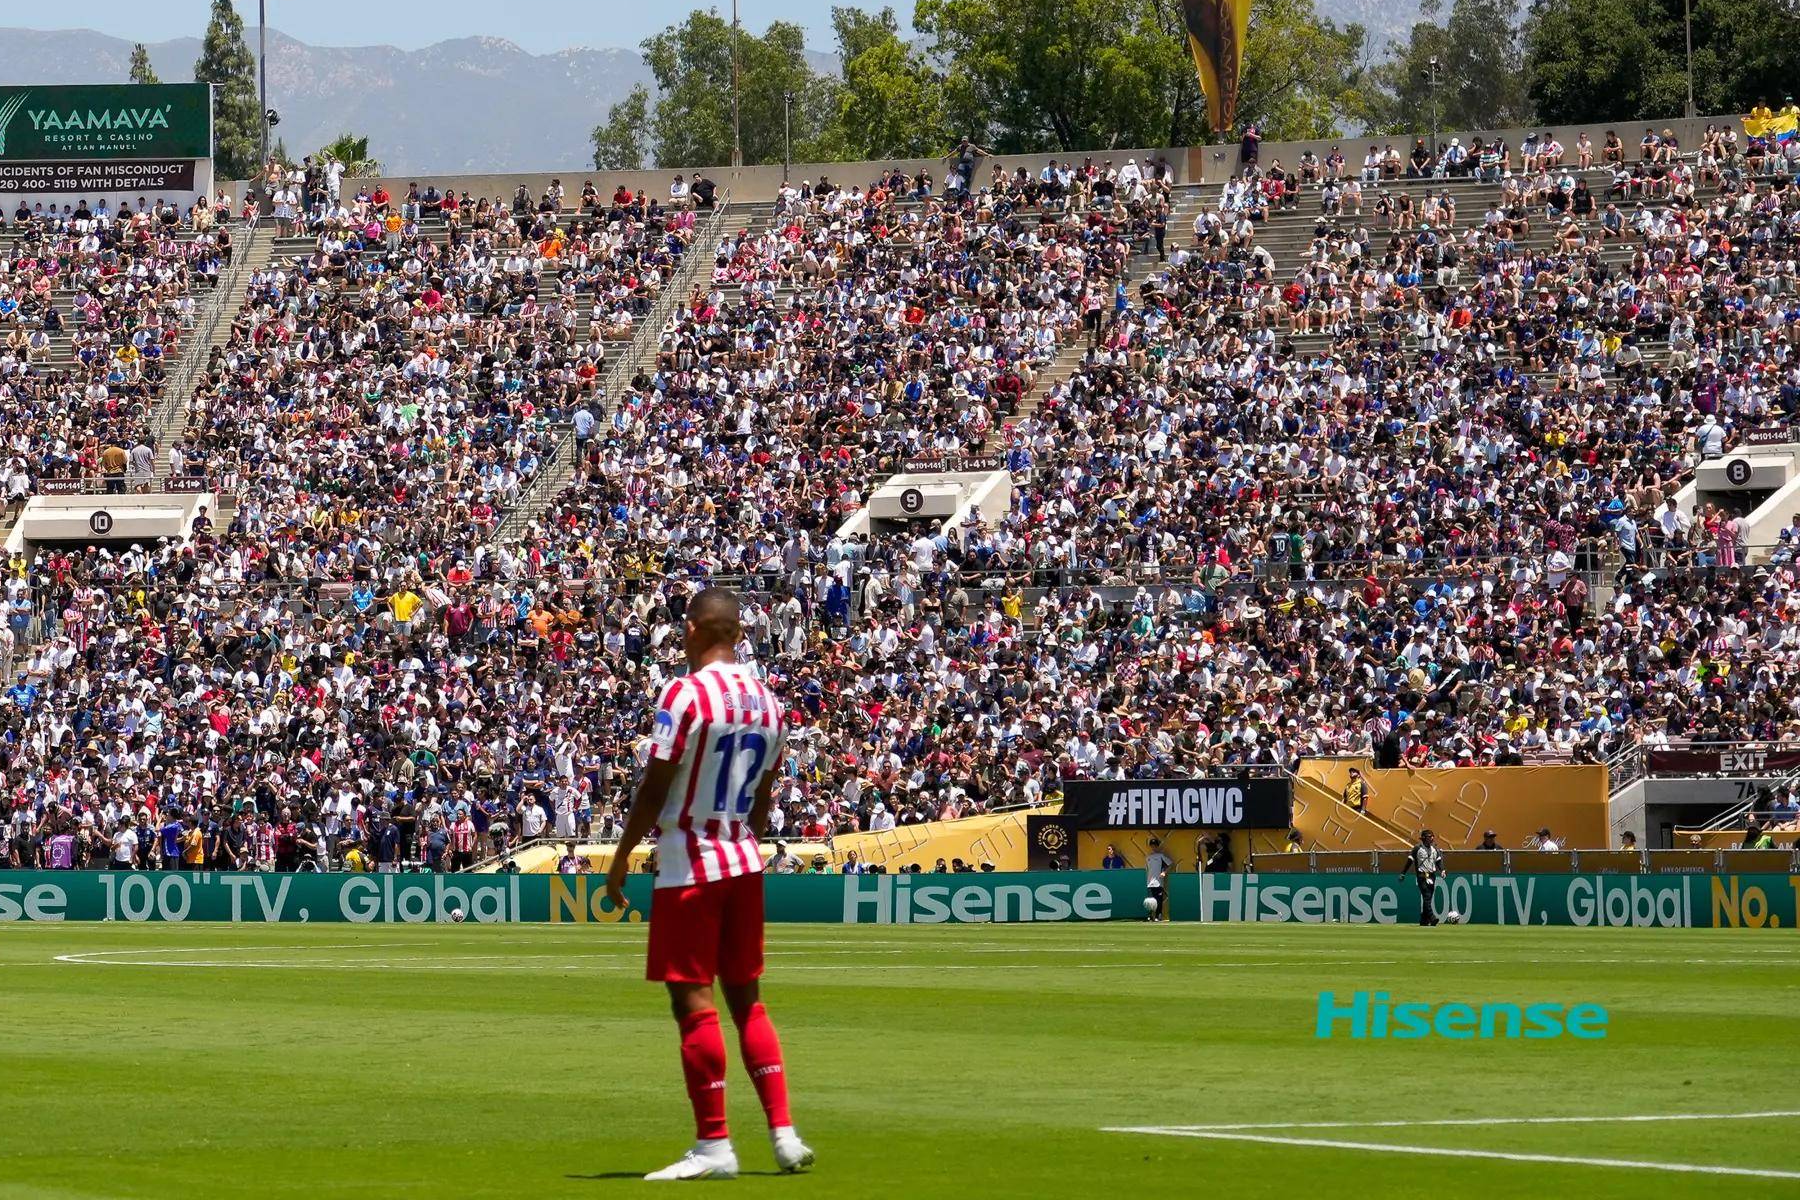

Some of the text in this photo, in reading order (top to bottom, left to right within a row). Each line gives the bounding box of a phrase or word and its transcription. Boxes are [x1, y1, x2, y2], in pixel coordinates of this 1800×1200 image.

[44, 134, 90, 142] RESORT
[110, 133, 153, 141] CASINO
[57, 166, 74, 176] OF
[77, 166, 101, 175] FAN
[104, 164, 184, 175] MISCONDUCT
[53, 179, 77, 188] 5119
[80, 178, 113, 188] WITH
[115, 177, 164, 188] DETAILS
[1759, 431, 1787, 441] 101-141
[915, 462, 941, 470] 101-141
[963, 459, 986, 468] 1-41
[1733, 465, 1744, 480] 8
[54, 482, 80, 490] 101-141
[906, 493, 917, 508] 9
[93, 516, 108, 530] 10
[1276, 540, 1285, 552] 10
[1720, 752, 1768, 771] EXIT
[714, 732, 767, 814] 12
[1108, 787, 1243, 825] #FIFACWC
[98, 873, 211, 922] 100"
[229, 875, 311, 923] TV,
[339, 875, 522, 924] Global
[550, 875, 641, 923] No.
[843, 874, 1113, 923] Hisense
[1201, 873, 1800, 928] Hisense 00" TV, Global No. 1
